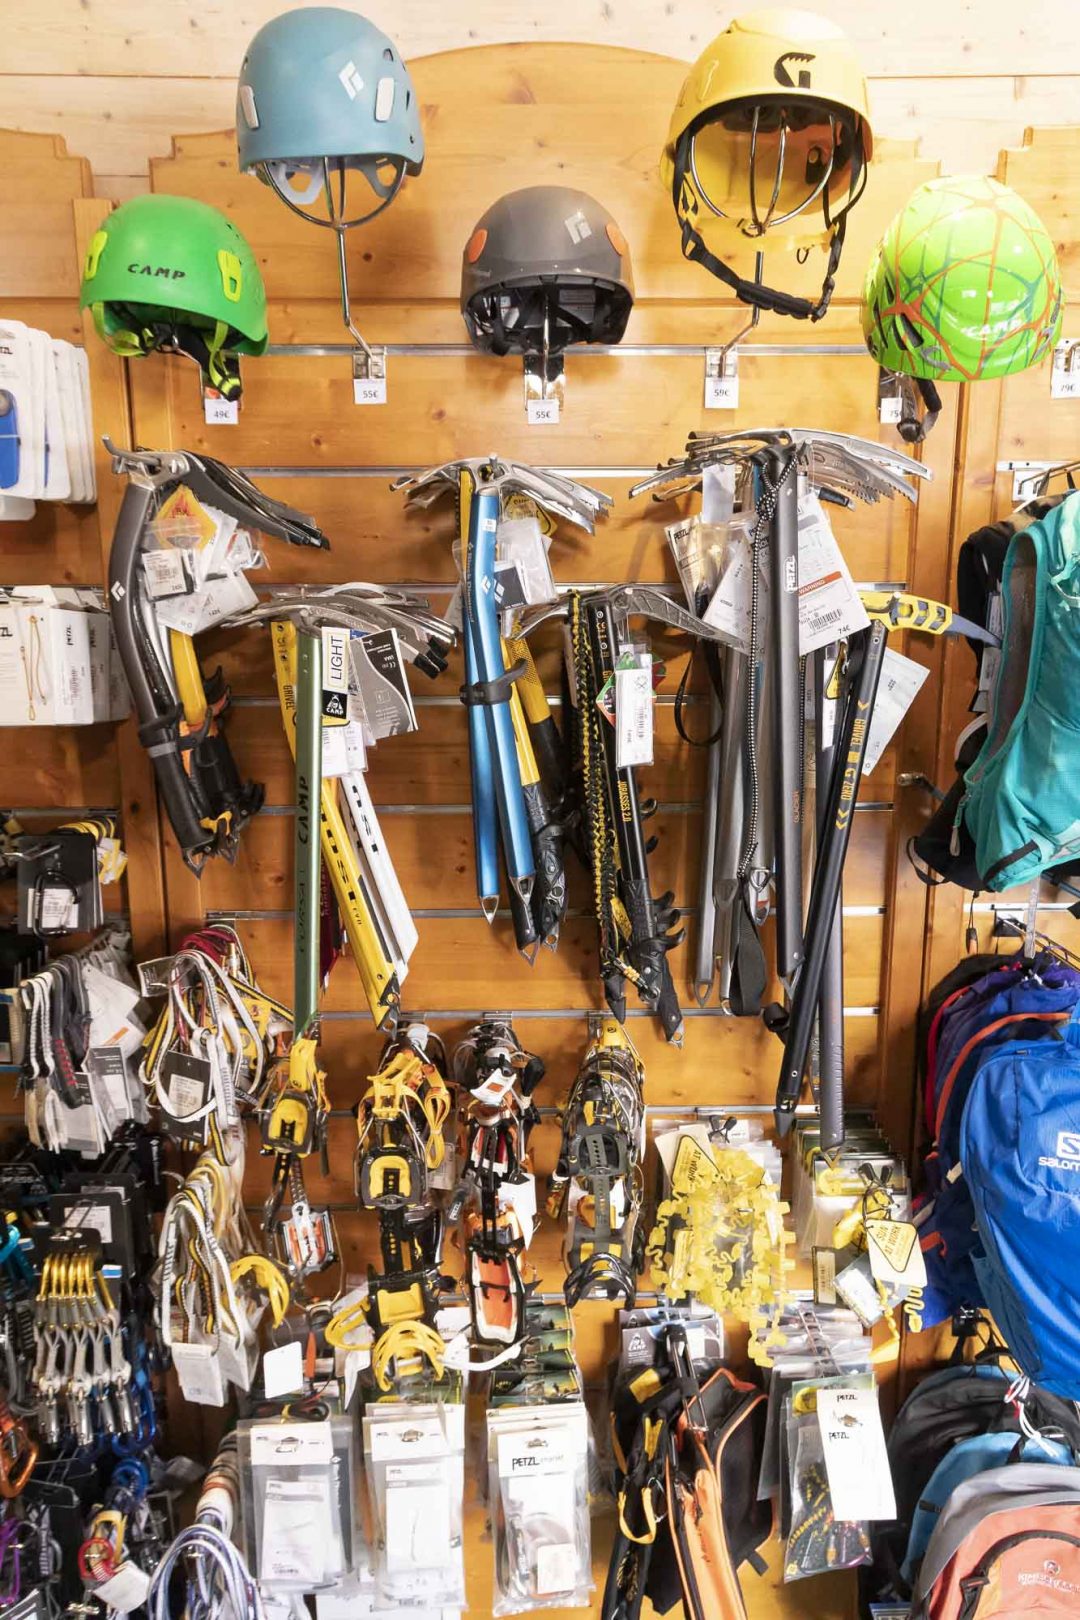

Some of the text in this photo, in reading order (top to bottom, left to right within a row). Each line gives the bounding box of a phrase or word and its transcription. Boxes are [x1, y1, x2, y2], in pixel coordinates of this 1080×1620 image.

[128, 263, 186, 280] CAMP
[363, 390, 378, 398] 55€
[214, 409, 230, 419] 49€
[536, 410, 550, 419] 55€
[784, 555, 798, 592] PETZL
[331, 635, 343, 681] LIGHT
[283, 685, 296, 710] GRIVEL
[325, 705, 344, 716] CAMP
[851, 718, 866, 746] GRIVEL
[841, 780, 855, 801] ZERO
[298, 775, 309, 844] CAMP
[617, 780, 632, 822] JORASSES 2.0
[836, 1394, 858, 1402] PETZL
[828, 1431, 850, 1441] PETZL
[512, 1456, 541, 1471] PETZL
